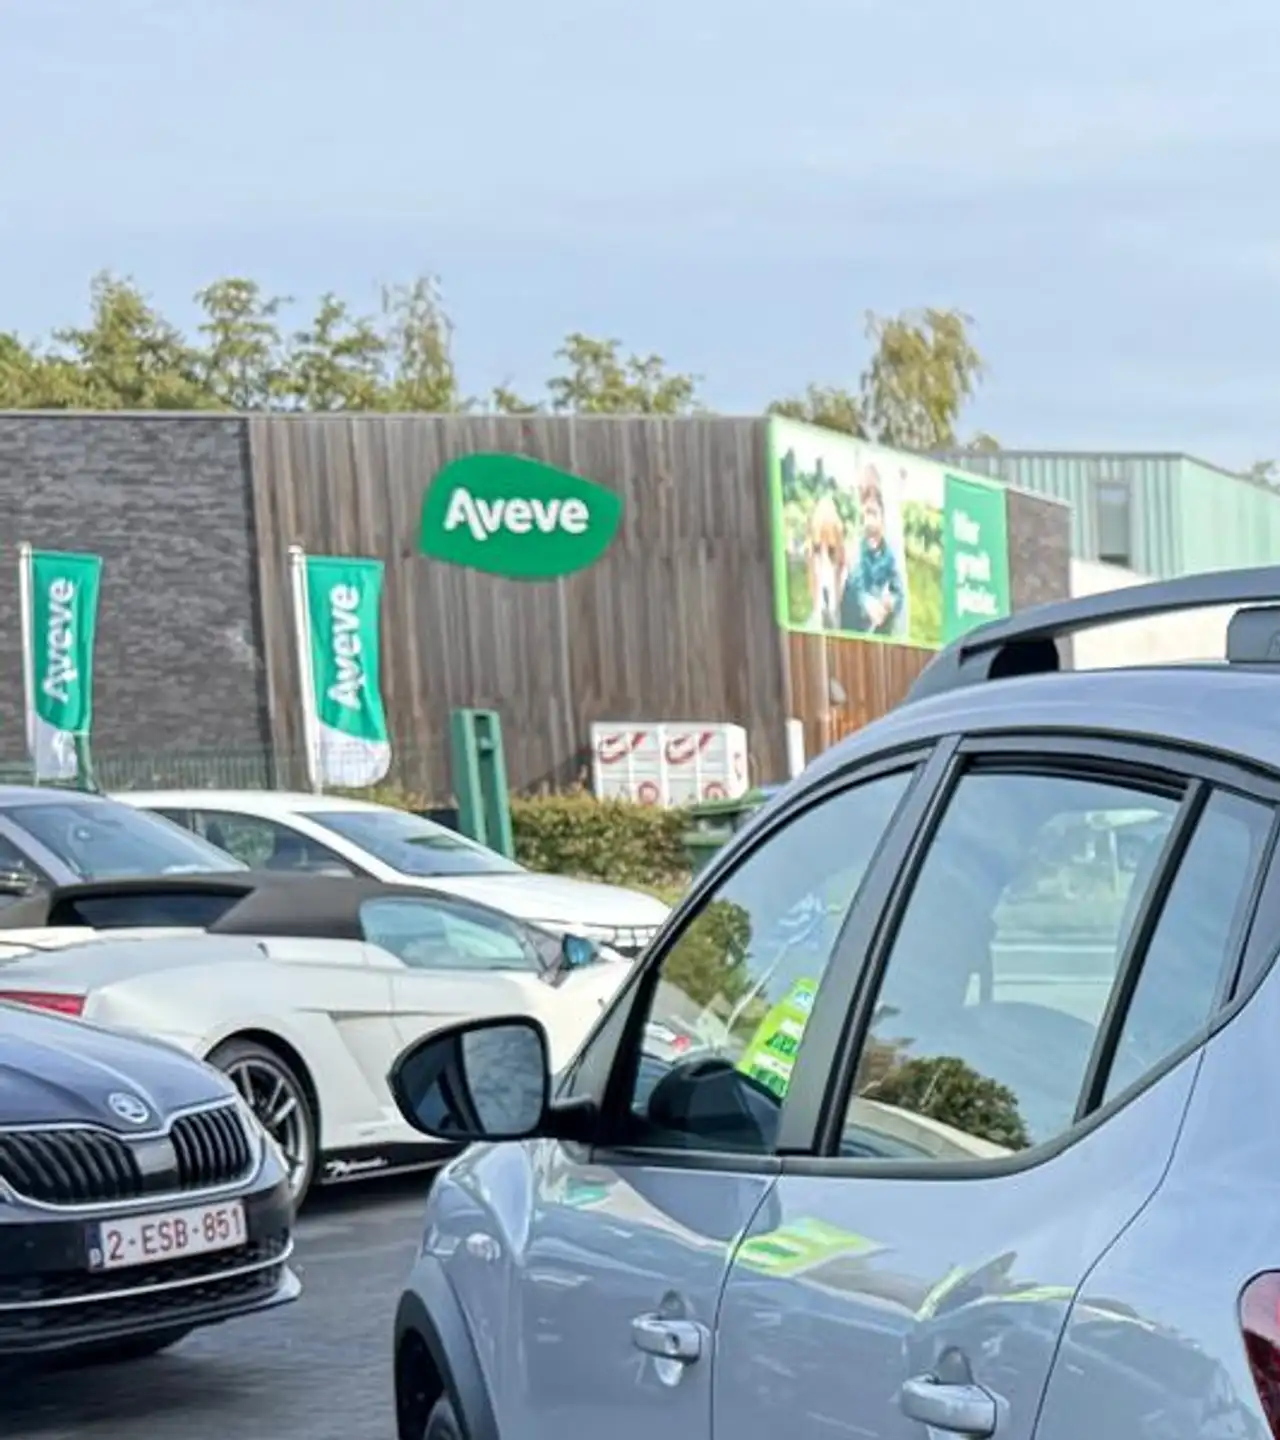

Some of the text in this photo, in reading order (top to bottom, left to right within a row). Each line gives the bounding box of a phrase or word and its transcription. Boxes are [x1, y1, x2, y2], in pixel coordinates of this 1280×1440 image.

[443, 487, 589, 541] Aveve
[42, 577, 78, 704] Aveve
[327, 583, 366, 710] Aveve
